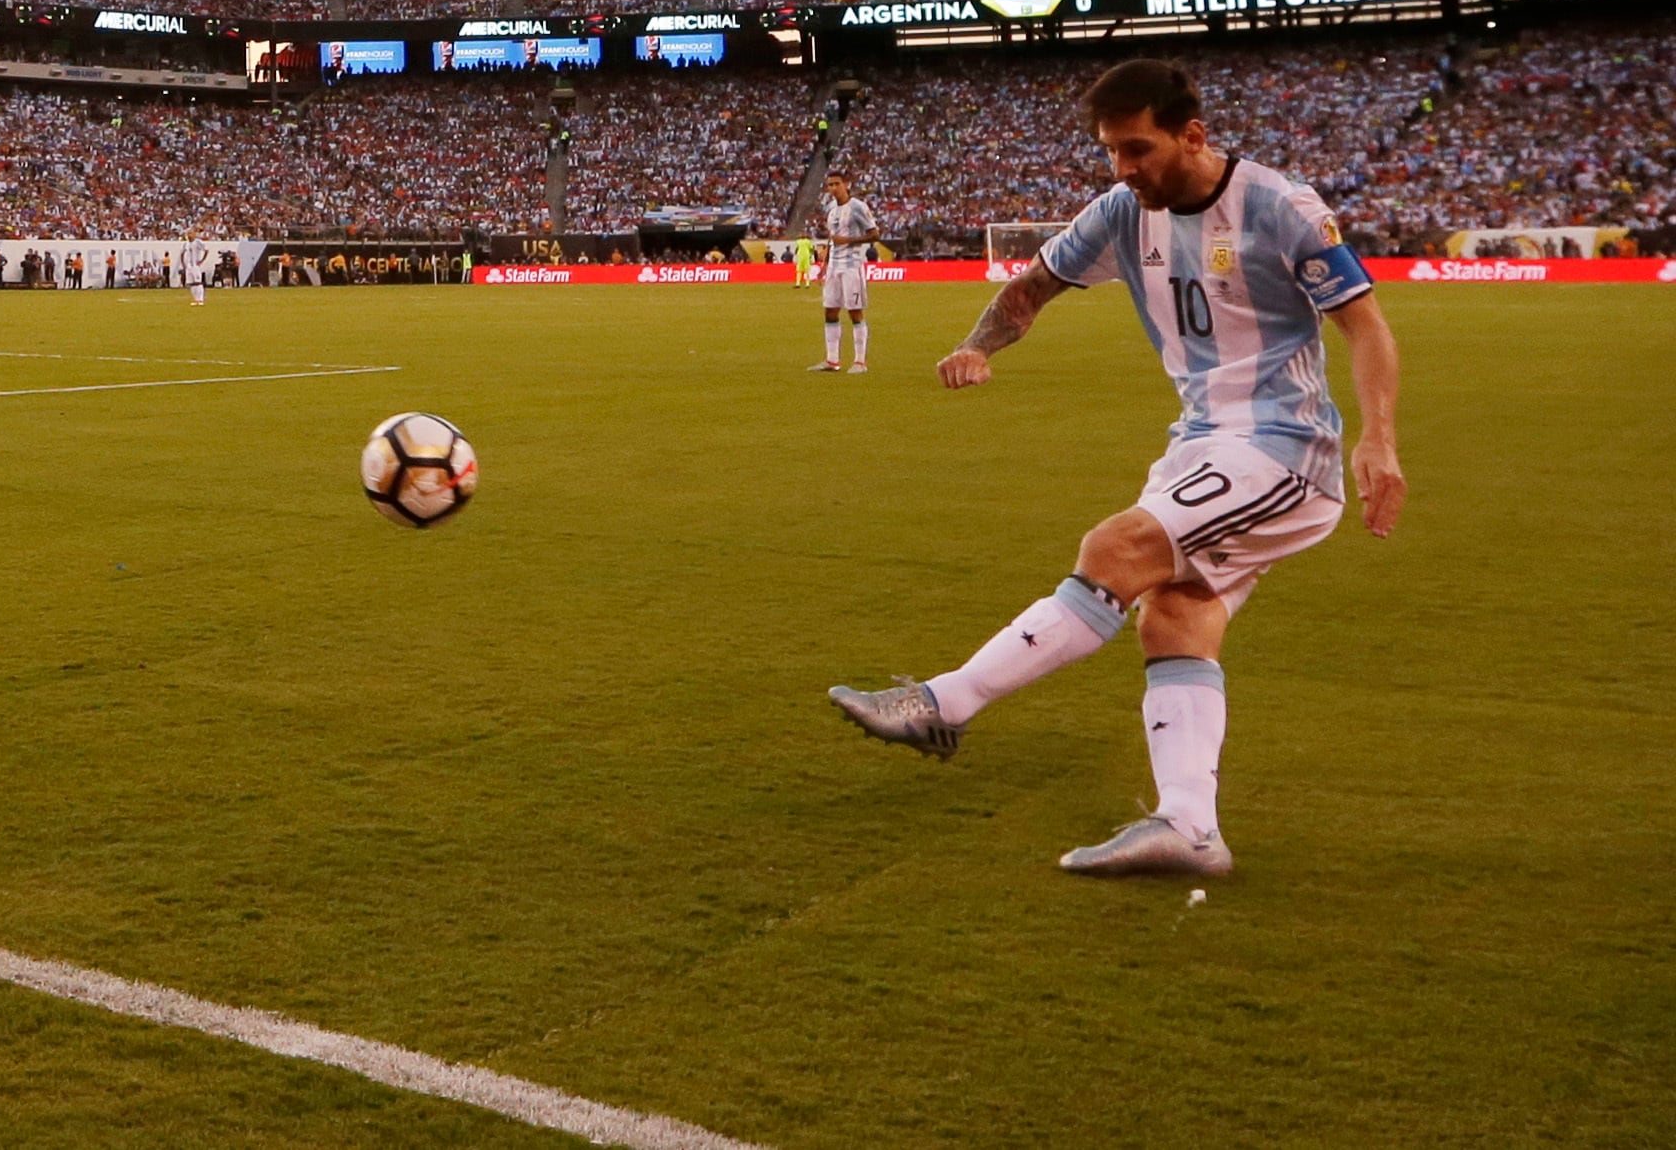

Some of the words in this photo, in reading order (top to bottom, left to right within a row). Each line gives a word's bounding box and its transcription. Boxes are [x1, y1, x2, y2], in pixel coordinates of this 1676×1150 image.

[94, 11, 187, 34] MERCURIAL
[646, 14, 740, 31] MERCURIAL
[841, 0, 978, 25] ARGENTINA
[458, 20, 551, 37] MERCURIAL
[523, 240, 562, 257] USA
[853, 293, 859, 304] 7
[1169, 277, 1213, 337] 10
[1162, 462, 1232, 507] 10
